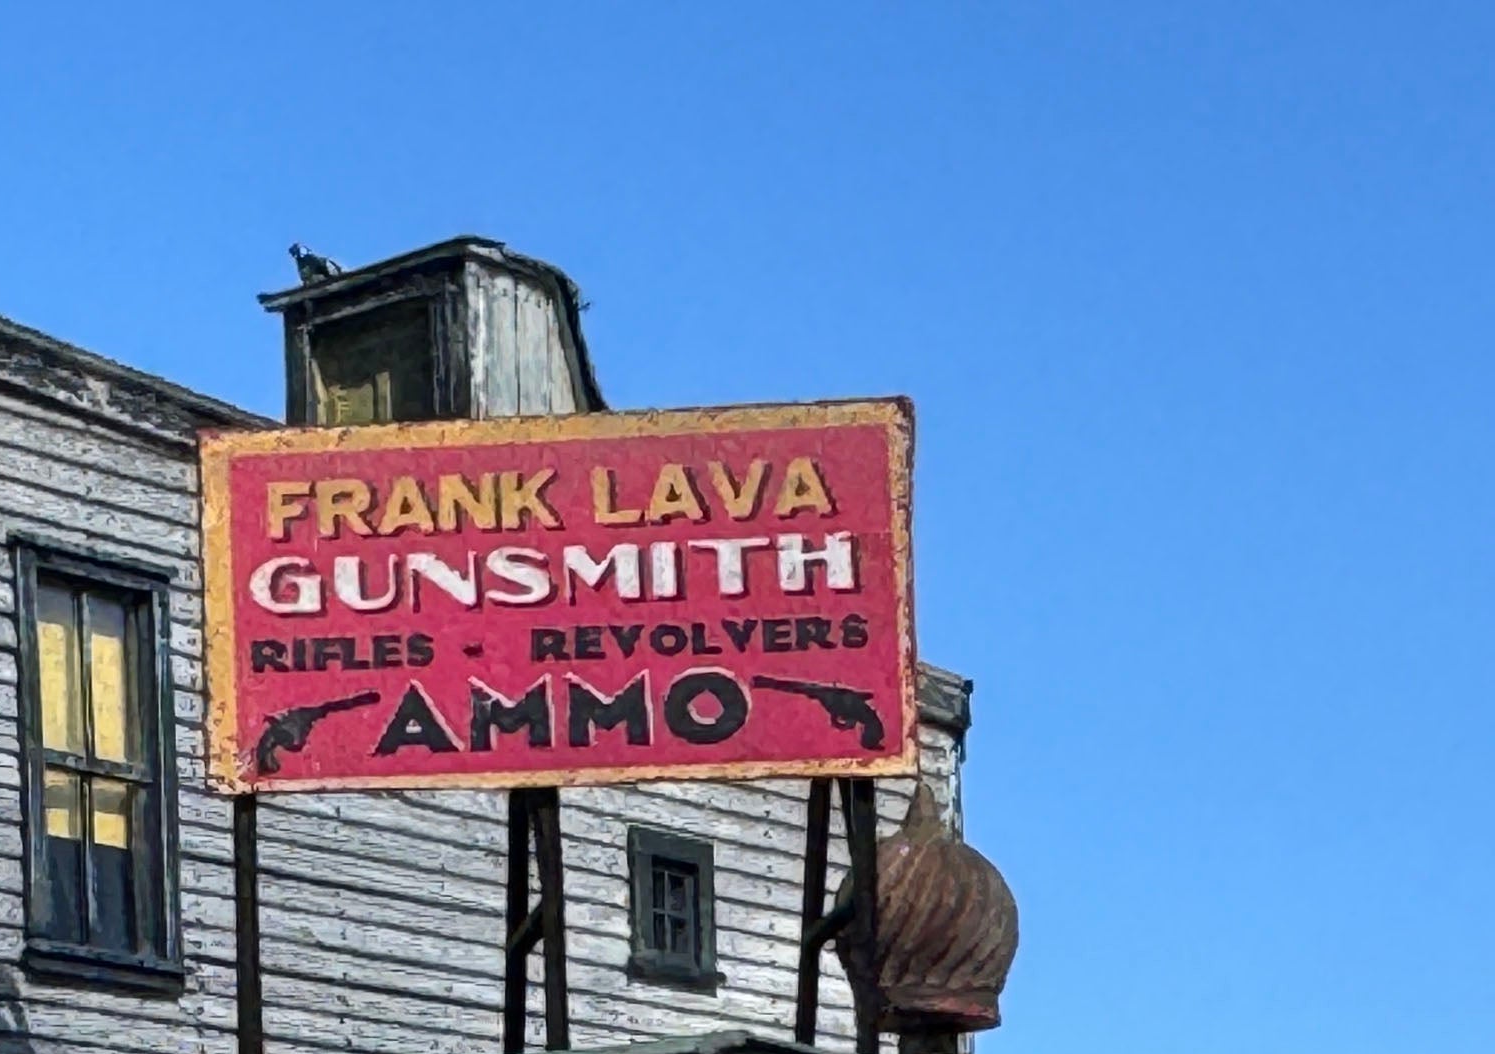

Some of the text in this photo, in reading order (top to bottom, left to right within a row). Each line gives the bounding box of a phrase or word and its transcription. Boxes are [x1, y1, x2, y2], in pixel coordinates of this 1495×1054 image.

[266, 456, 837, 541] FRANK LAVA
[248, 529, 857, 614] GUNSMITH
[250, 613, 869, 674] RIFLES REVOLVERS
[369, 666, 754, 756] AMMO
